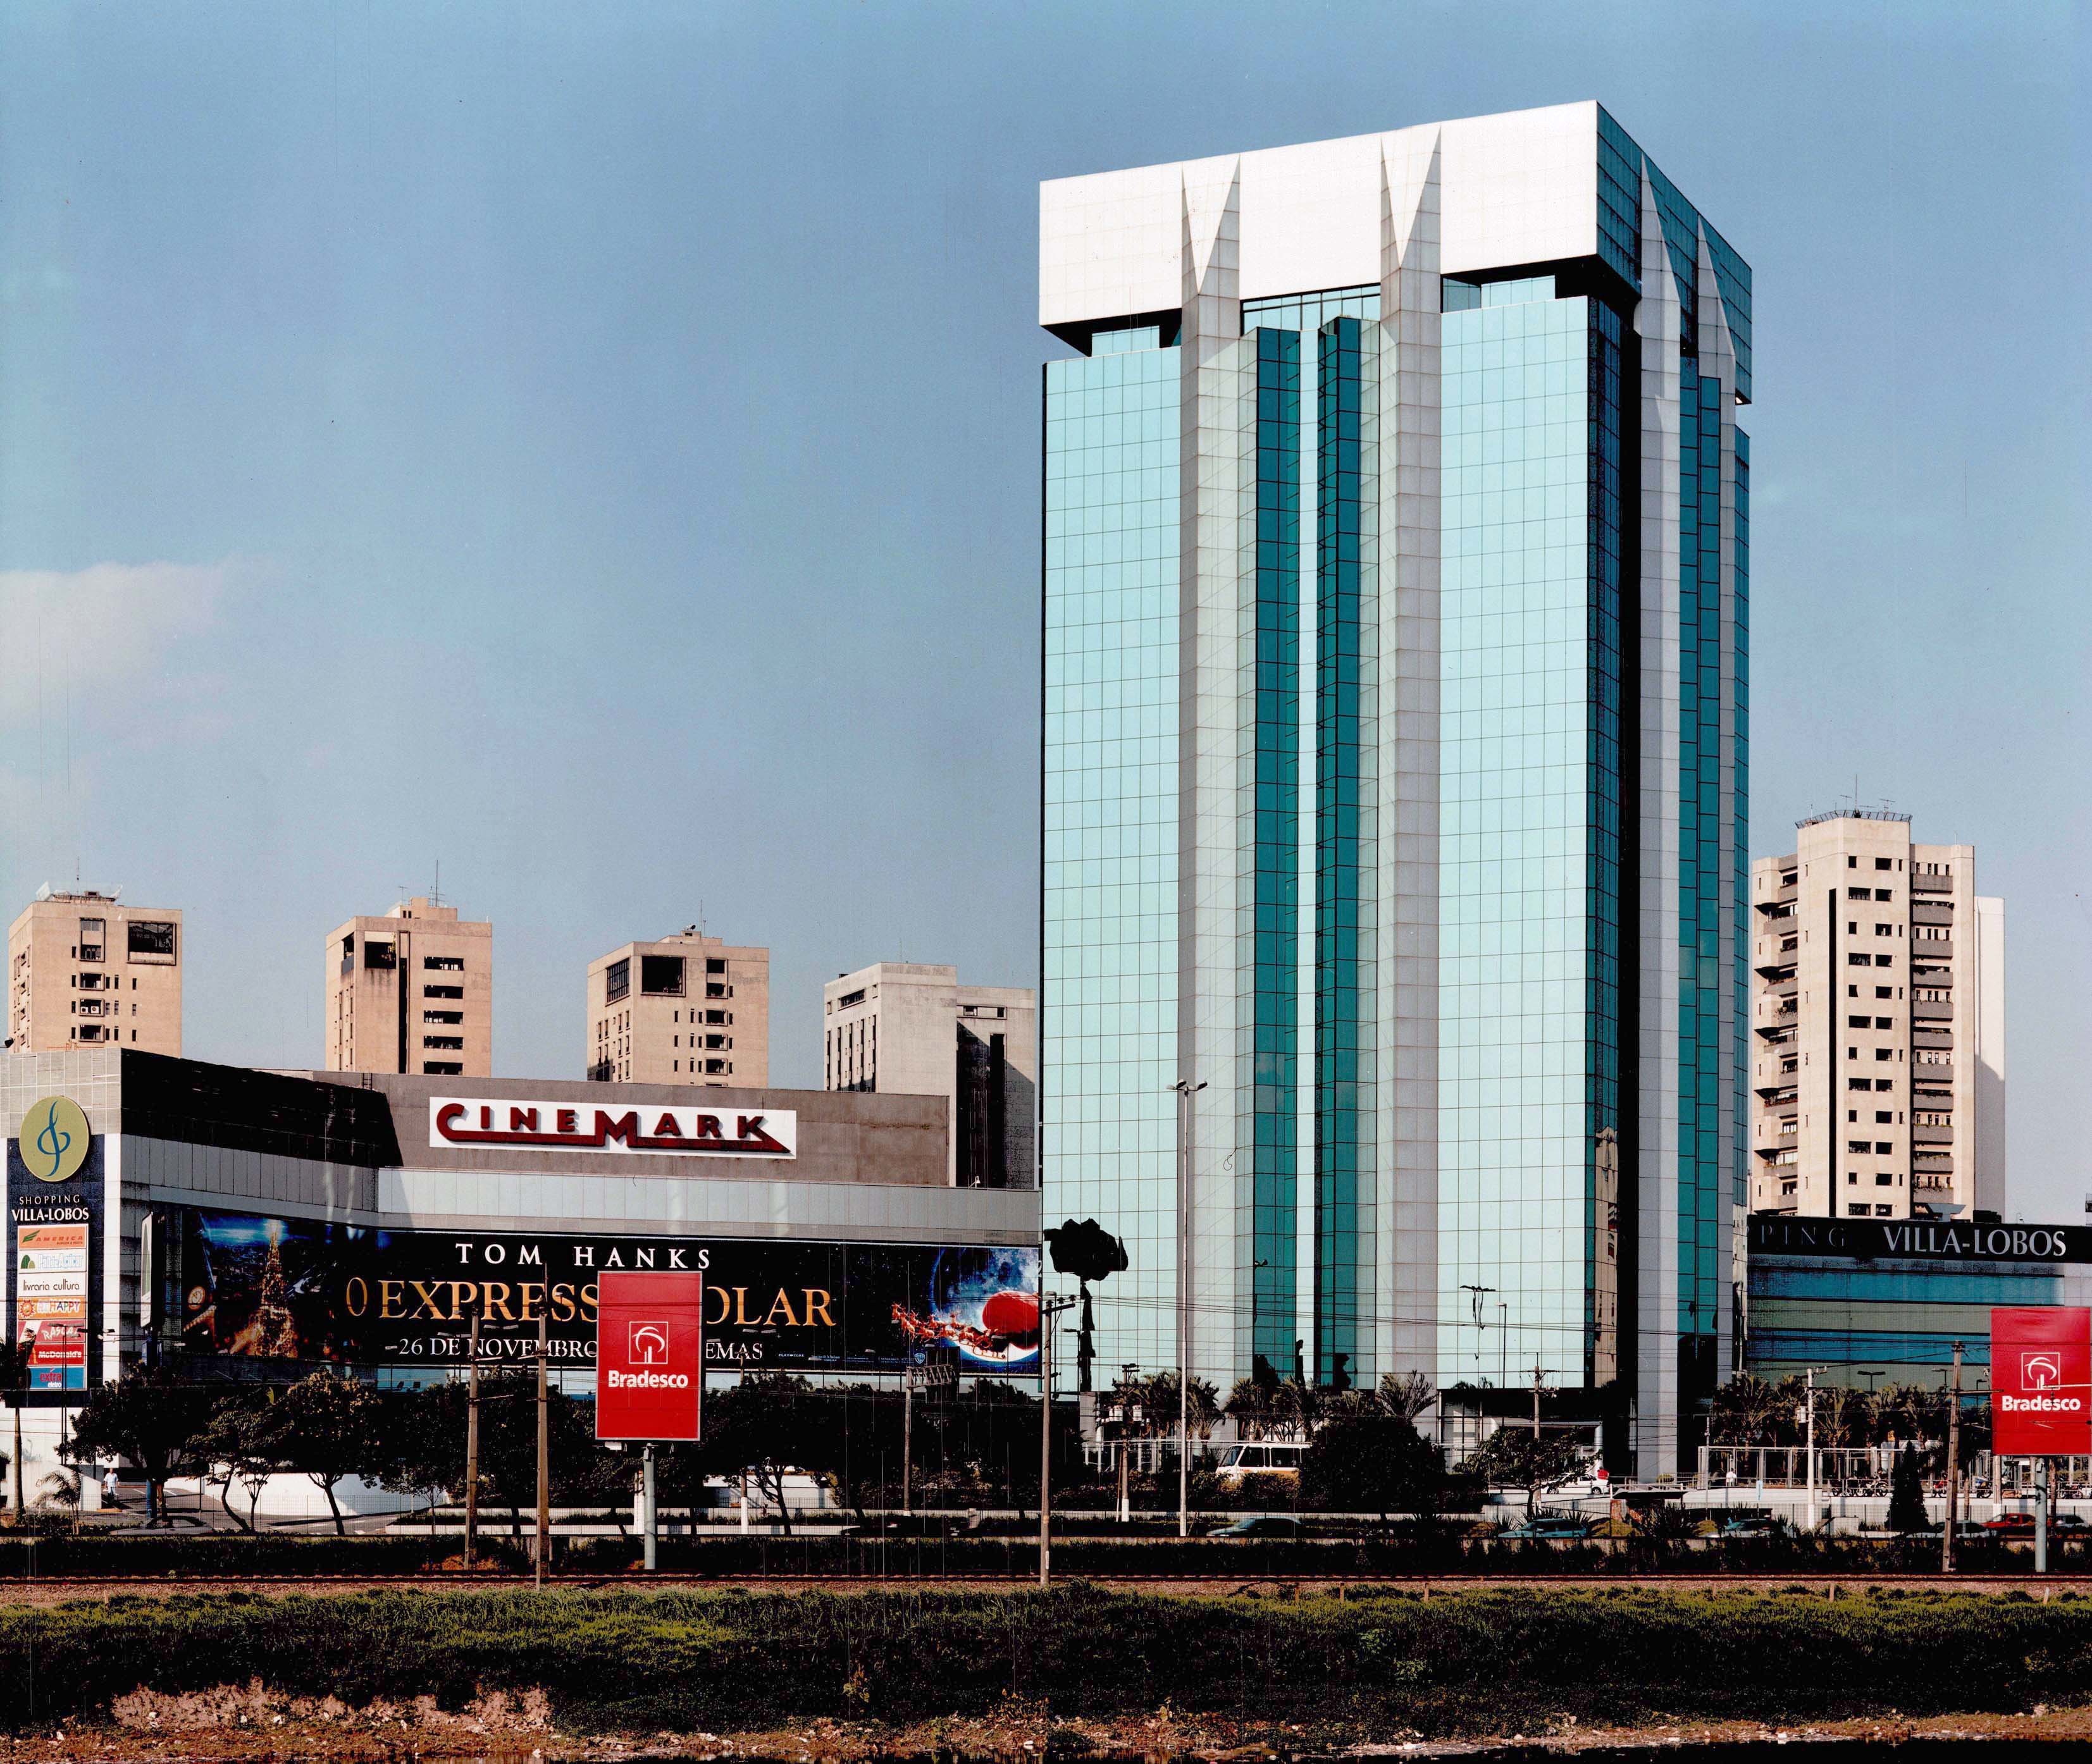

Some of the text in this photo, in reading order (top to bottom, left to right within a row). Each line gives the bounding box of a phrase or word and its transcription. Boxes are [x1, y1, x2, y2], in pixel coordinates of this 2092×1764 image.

[436, 1102, 789, 1154] CINEMARK
[19, 1194, 80, 1205] SHOPPING
[11, 1207, 89, 1221] VILLA-LOBOS
[1883, 1226, 2067, 1256] VILLA-LOBOS
[455, 1243, 710, 1269] TOM HANKS
[23, 1279, 80, 1291] livraria cultura
[49, 1300, 80, 1312] HAPPY
[378, 1280, 597, 1323] EXPRESS
[706, 1286, 836, 1326] OLAR
[38, 1350, 82, 1359] McDonald's
[399, 1338, 423, 1355] 26
[430, 1338, 461, 1356] DE
[705, 1342, 762, 1360] EMAS
[40, 1371, 62, 1382] extra
[608, 1370, 689, 1388] Bradesco
[2002, 1395, 2081, 1411] Bradesco
